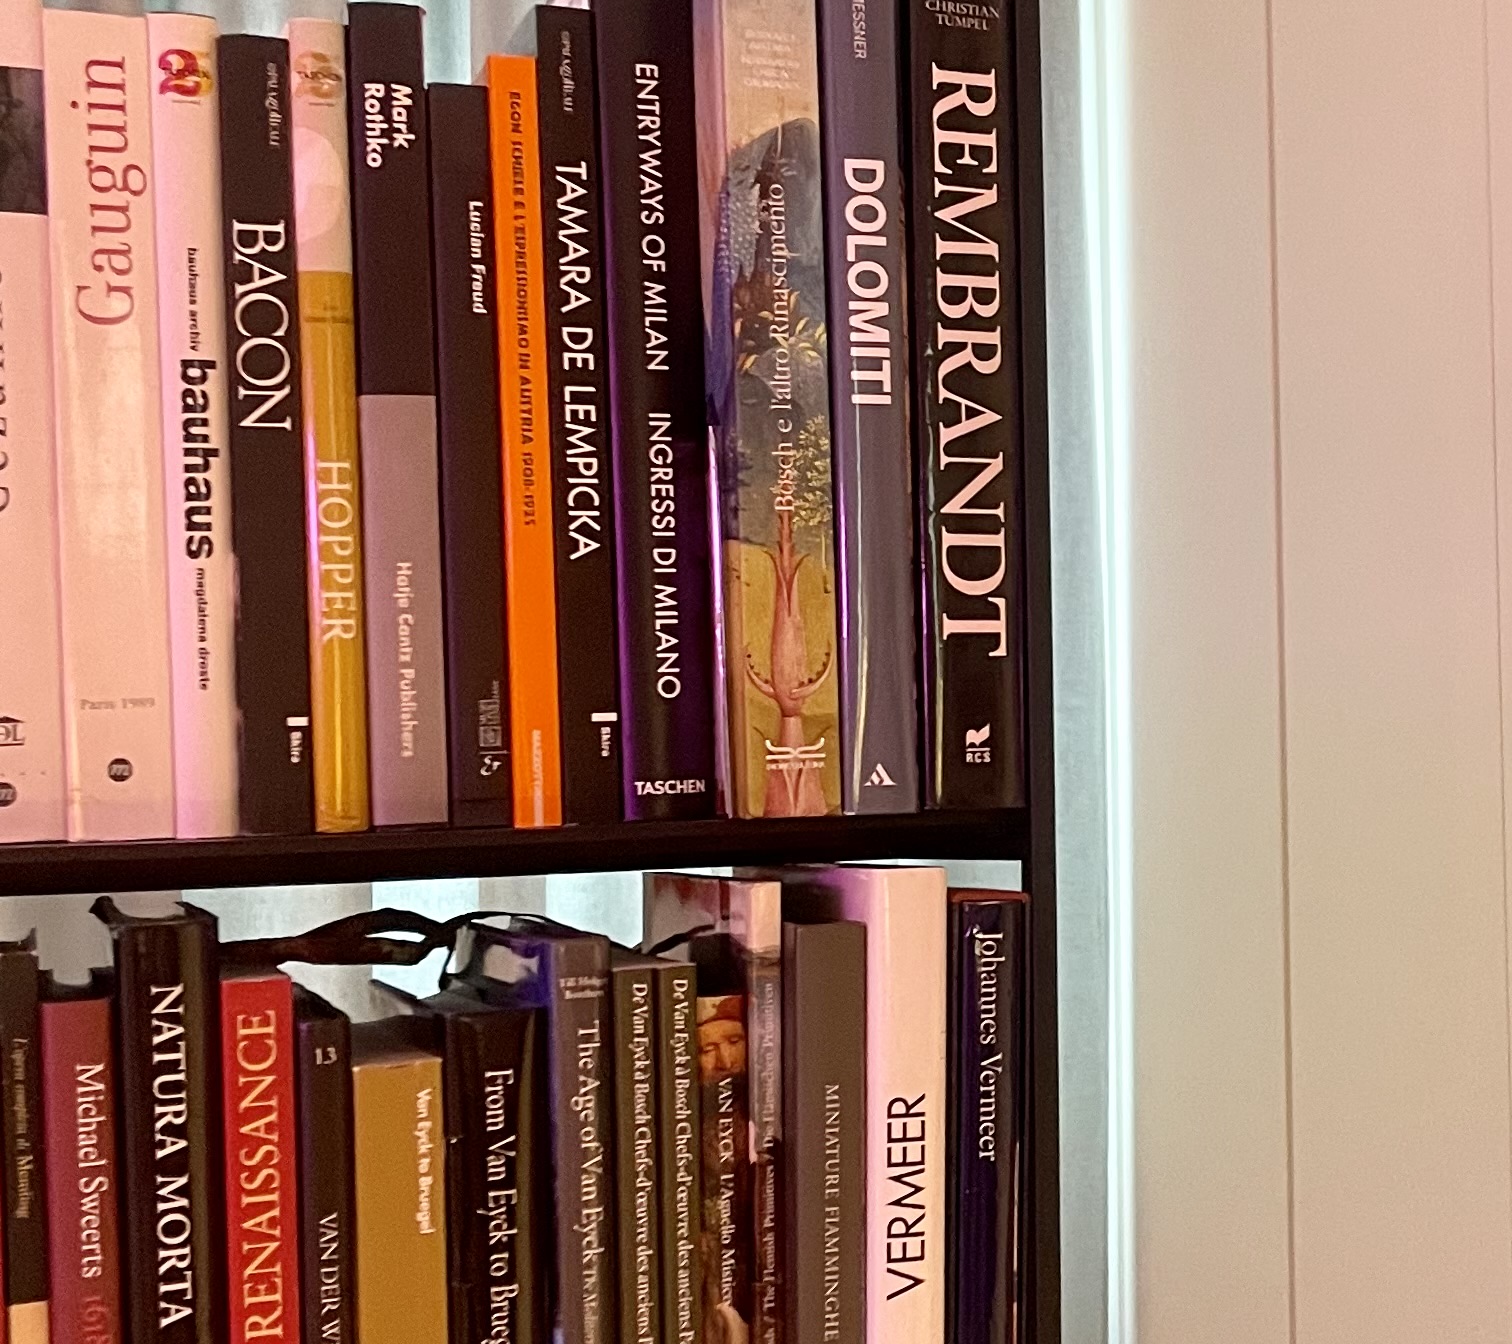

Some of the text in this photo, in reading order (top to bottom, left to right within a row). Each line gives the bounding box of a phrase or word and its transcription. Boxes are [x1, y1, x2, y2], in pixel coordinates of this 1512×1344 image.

[362, 82, 387, 168] Rothko
[390, 82, 416, 149] Mark
[509, 91, 523, 134] EGON
[71, 56, 148, 326] Gauguin
[467, 200, 488, 314] Lucian Freud
[844, 157, 892, 406] DOLOMITI
[232, 219, 292, 431] BACON
[765, 182, 795, 512] Bosch e l'altro Rinascimento
[556, 160, 601, 561] TAMARA DE LEMPICKA
[635, 63, 681, 698] ENTRYWAYS OF MILAN INGRESSI DI MILANO
[931, 61, 1009, 657] REMBRANDT
[180, 247, 221, 692] bauhaus archiv bauhaus magdalena droste
[317, 459, 357, 644] HOPPER
[393, 562, 419, 757] Hatje Cantz Publishers
[633, 780, 707, 796] TASCHEN
[632, 984, 648, 1005] De
[672, 978, 690, 1000] De
[673, 1001, 690, 1031] Van
[577, 1020, 601, 1069] The
[632, 1005, 648, 1034] Van
[669, 1032, 690, 1065] Eyck
[974, 931, 1005, 1162] Johannes Vermeer
[628, 1036, 649, 1069] Eyck
[634, 1070, 652, 1080] à
[675, 1066, 693, 1076] à
[76, 1060, 108, 1166] Michael
[484, 1068, 515, 1132] From
[570, 1075, 602, 1123] Age
[633, 1082, 652, 1125] Bosch
[674, 1078, 693, 1120] Bosch
[718, 1077, 733, 1115] VAN
[149, 981, 194, 1328] NATURA MORTA
[414, 1087, 437, 1235] Van Eyck to Bruegel
[485, 1134, 517, 1182] Van
[579, 1126, 603, 1152] of
[718, 1117, 734, 1163] EYCK
[824, 1083, 839, 1199] MINIATURE
[236, 1008, 284, 1341] RENAISSANCE
[580, 1155, 604, 1202] Van
[885, 1092, 927, 1301] VERMEER
[78, 1174, 108, 1277] Sweerts
[318, 1211, 340, 1264] VAN
[477, 1189, 518, 1245] Eyck
[572, 1207, 606, 1264] Eyck
[714, 1173, 735, 1245] L'Agnello
[489, 1251, 512, 1277] to
[635, 1244, 653, 1272] des
[676, 1239, 694, 1267] des
[824, 1205, 839, 1341] FIAMMINGHE
[319, 1266, 341, 1316] DER
[636, 1273, 653, 1335] anciens
[677, 1268, 695, 1329] anciens
